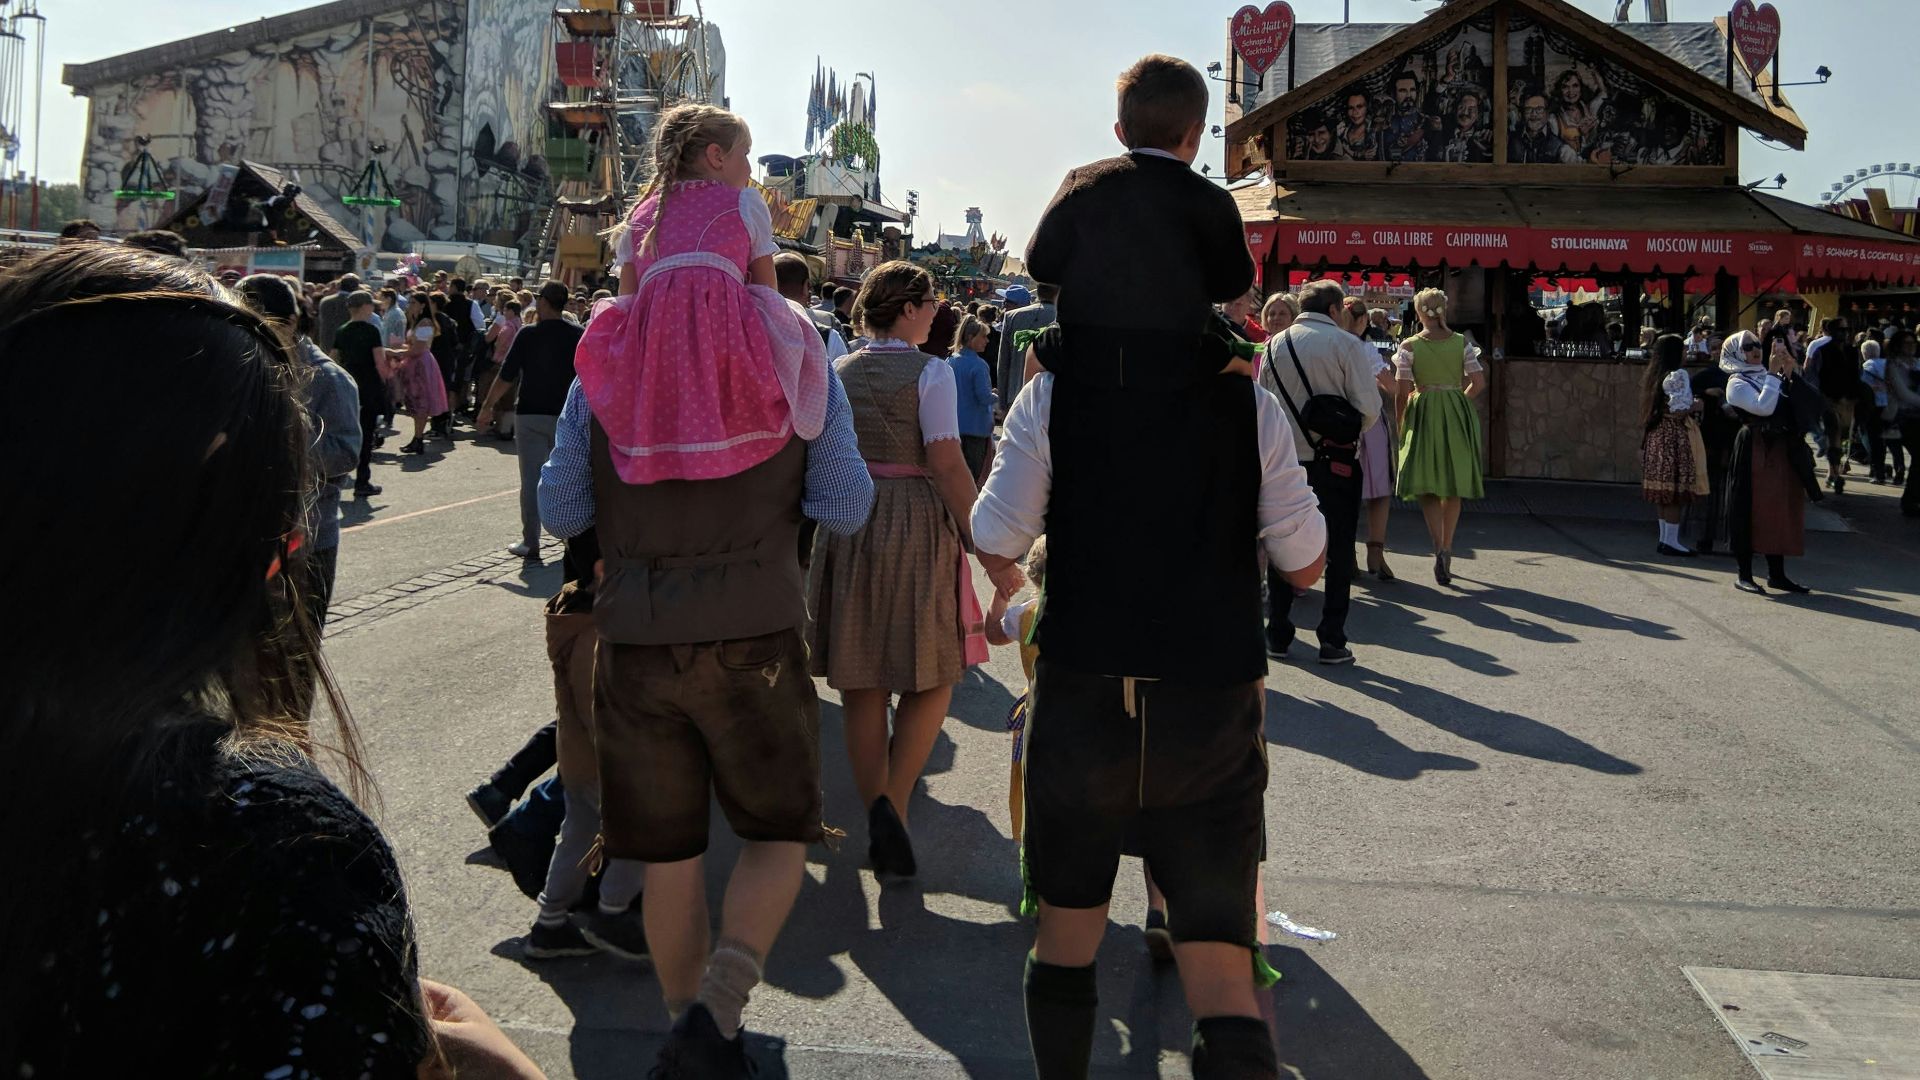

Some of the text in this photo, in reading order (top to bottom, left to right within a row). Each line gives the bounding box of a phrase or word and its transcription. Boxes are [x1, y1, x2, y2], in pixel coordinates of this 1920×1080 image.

[1242, 38, 1266, 47] Schnaps
[1246, 46, 1272, 55] Cocktails
[1297, 230, 1337, 245] MOJITO
[1372, 231, 1433, 246] CUBA LIBRE
[1446, 232, 1508, 248] CAIPIRINHA
[1551, 237, 1628, 250] STOLICHNAYA
[1646, 238, 1732, 254] MOSCOW MULE
[1826, 247, 1858, 258] SCHNAPS
[1860, 248, 1866, 260] &
[1867, 251, 1904, 262] COCKTAILS
